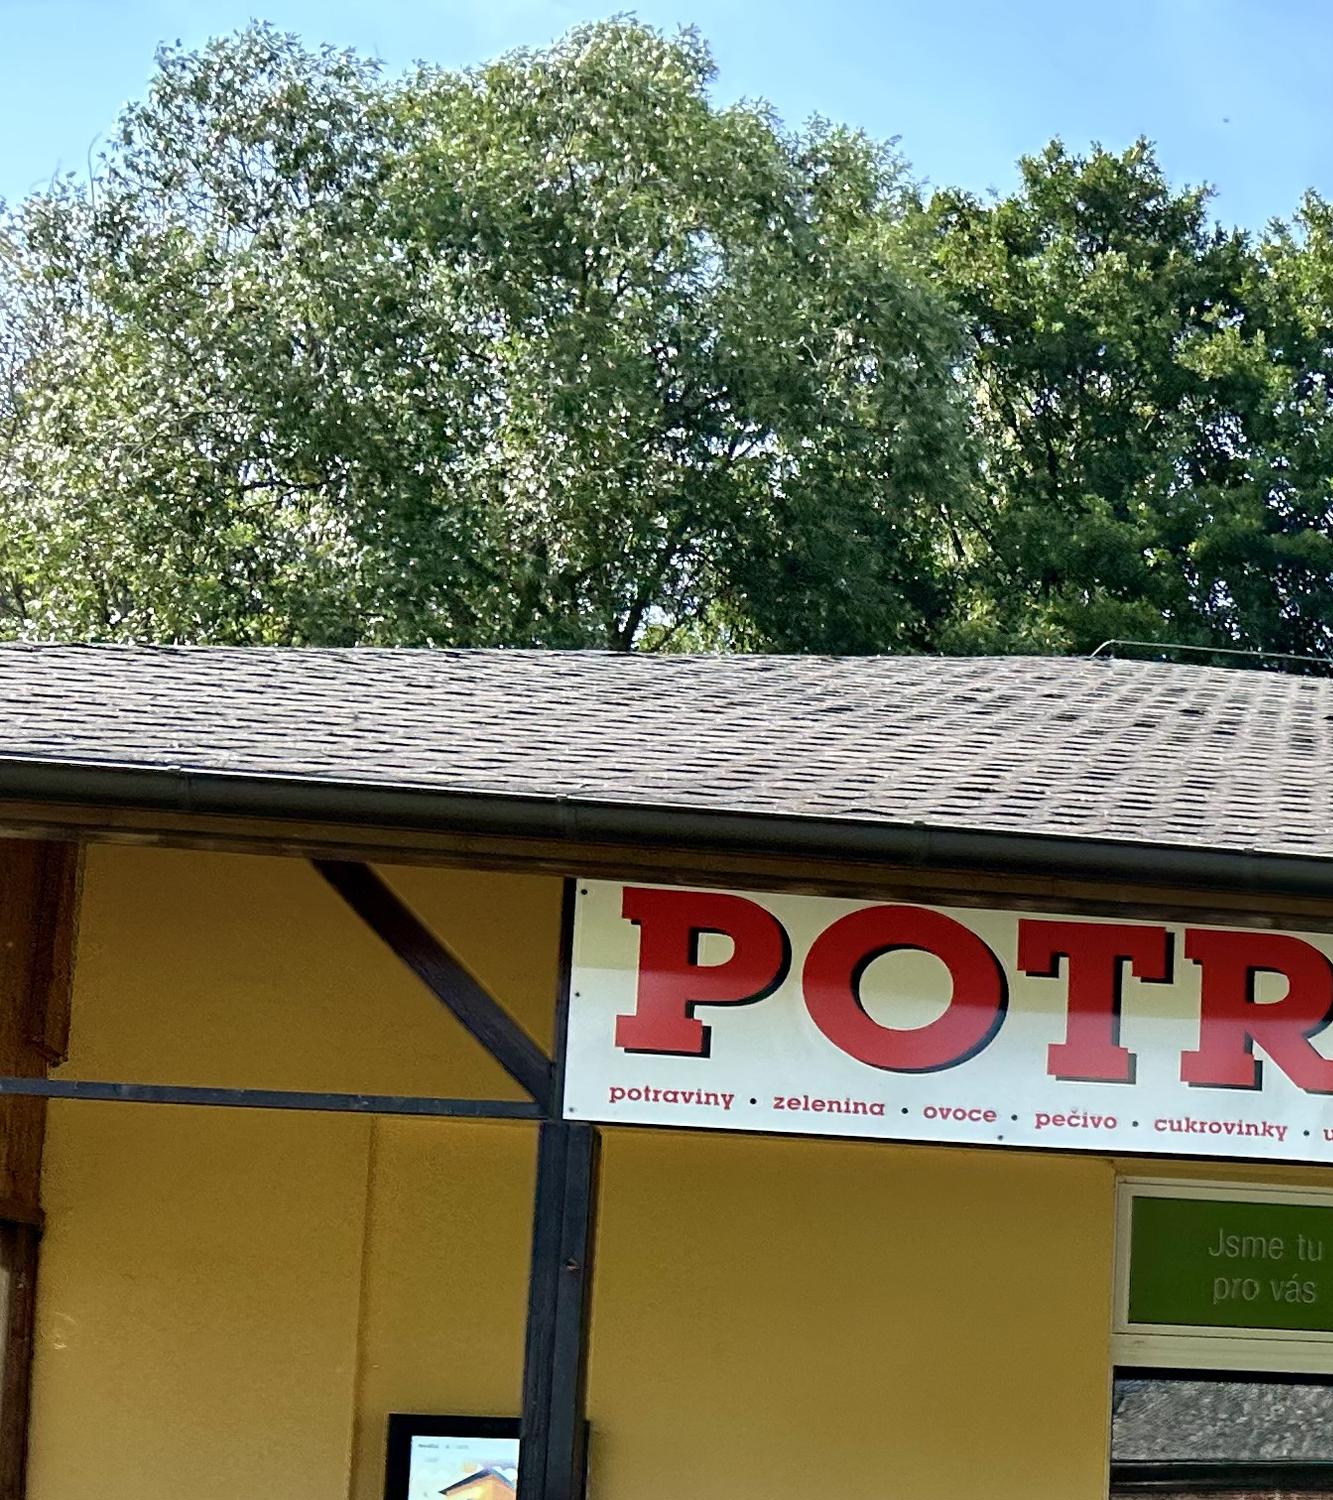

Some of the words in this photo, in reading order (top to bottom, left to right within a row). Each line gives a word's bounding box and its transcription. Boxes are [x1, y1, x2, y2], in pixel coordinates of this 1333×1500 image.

[608, 1084, 735, 1111] potraviny
[772, 1094, 886, 1116] zelenina
[923, 1104, 998, 1123] ovoce
[1034, 1107, 1118, 1130] pečivo
[1153, 1115, 1289, 1141] cukrovinky
[1207, 1228, 1284, 1260] Jsme
[1296, 1234, 1322, 1262] tu
[1212, 1275, 1260, 1305] pro
[1270, 1271, 1317, 1305] vás
